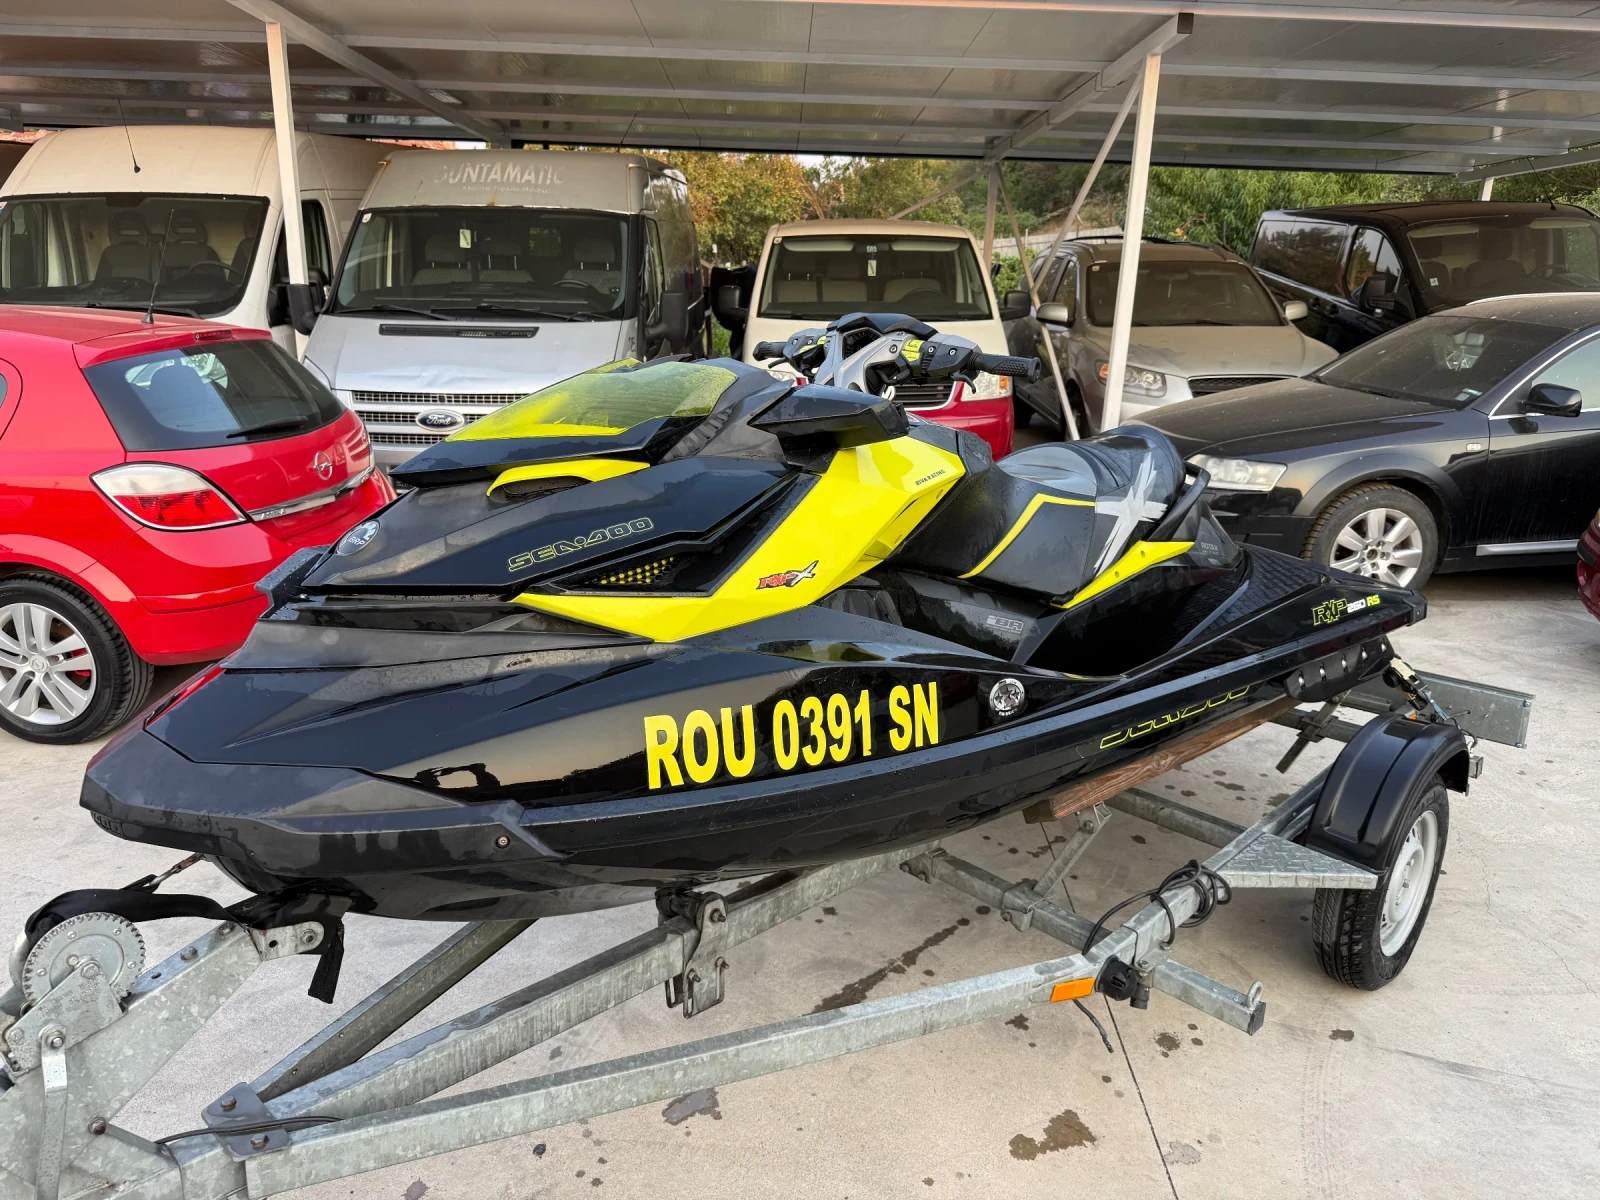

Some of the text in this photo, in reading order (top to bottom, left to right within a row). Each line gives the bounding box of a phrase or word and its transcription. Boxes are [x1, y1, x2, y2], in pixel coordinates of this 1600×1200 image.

[426, 414, 452, 426] Ford
[349, 536, 366, 546] BRP
[1347, 598, 1367, 613] 260
[1366, 594, 1381, 607] RS
[644, 704, 756, 790] ROU
[773, 689, 872, 771] 0391
[888, 681, 939, 752] SN
